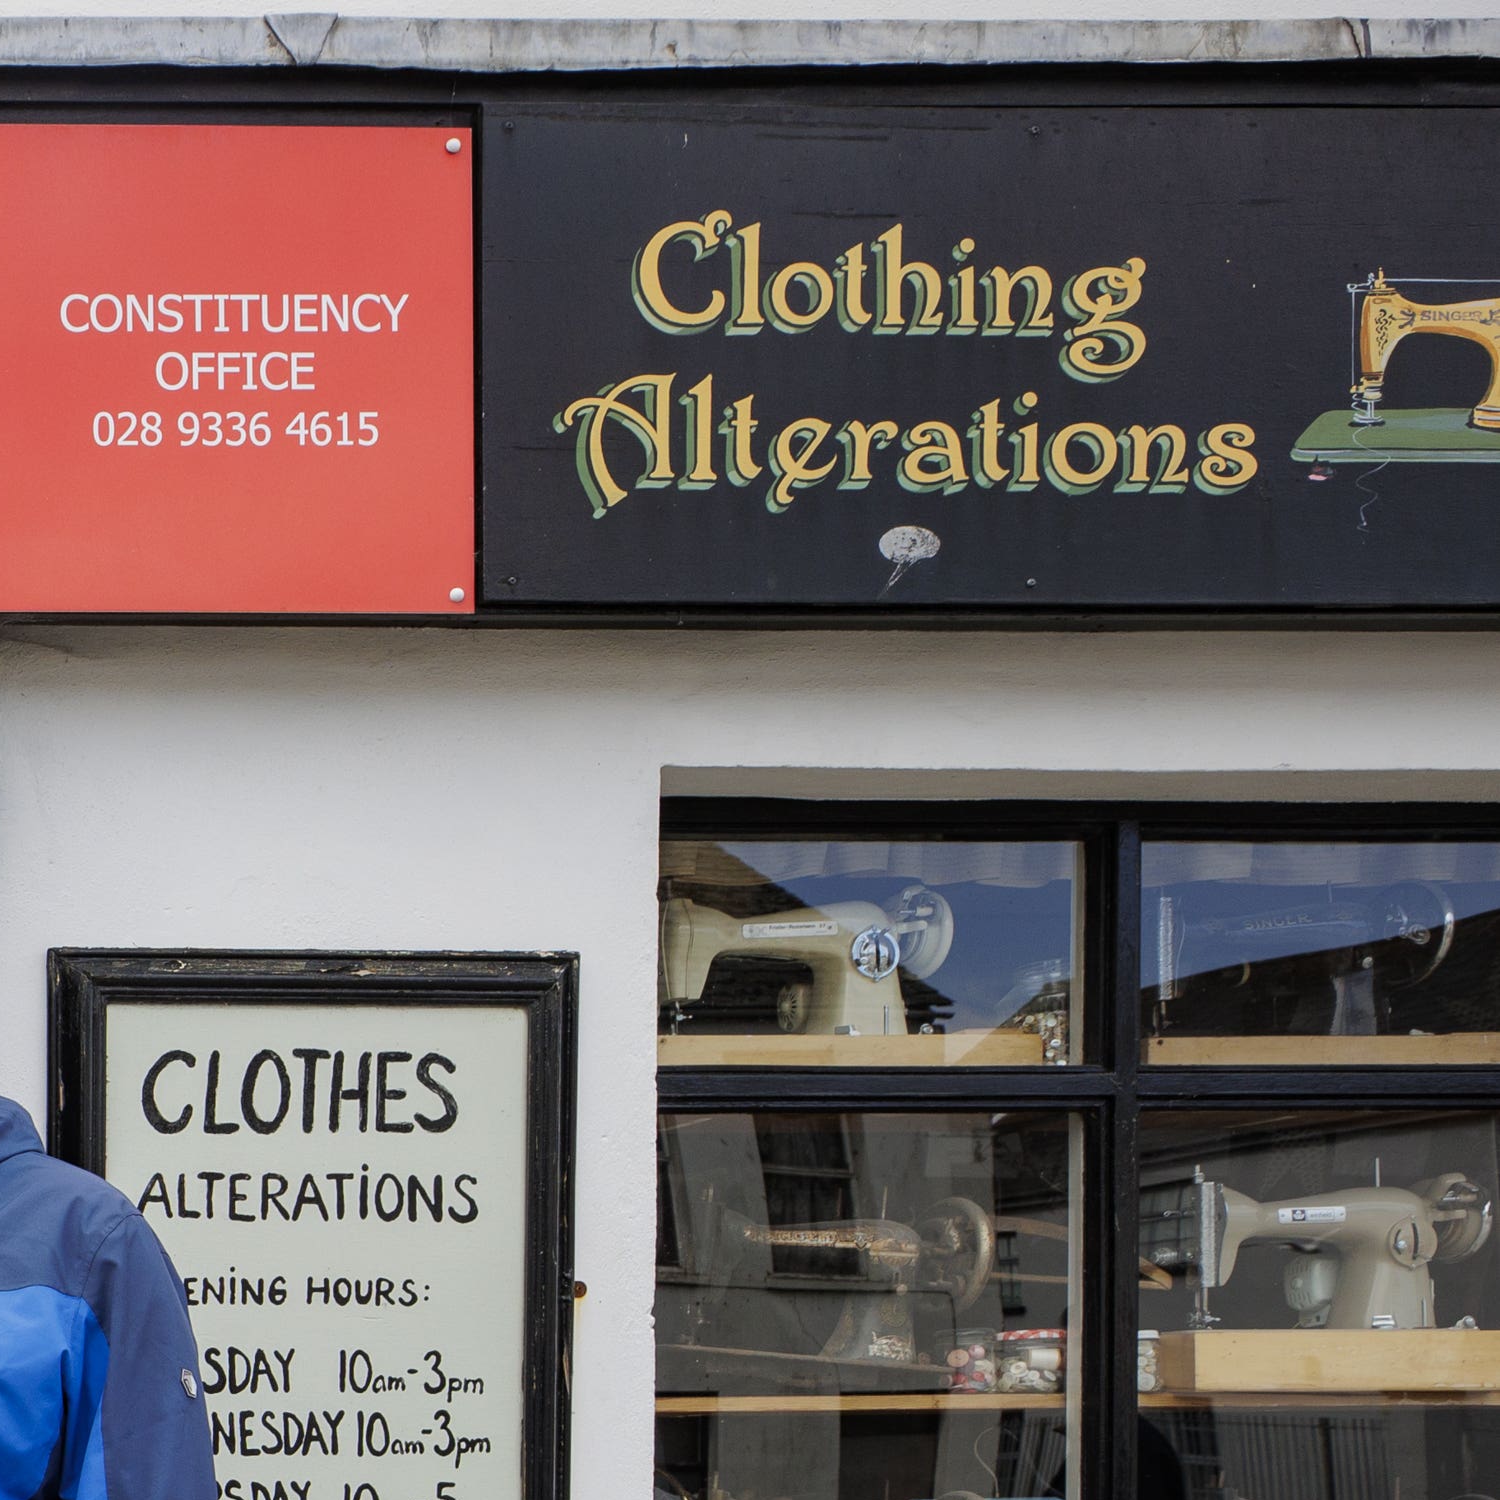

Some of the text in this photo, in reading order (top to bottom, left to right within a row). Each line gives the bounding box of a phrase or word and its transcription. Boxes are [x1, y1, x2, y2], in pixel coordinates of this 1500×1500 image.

[60, 293, 409, 333] CONSTITUENCY
[631, 208, 1148, 383] Clothing
[1420, 309, 1482, 322] SINGER
[155, 351, 315, 391] OFFICE
[92, 411, 379, 447] 028 9336 4615
[552, 371, 1260, 519] Alterations
[141, 1048, 459, 1136] CLOTHES
[138, 1163, 479, 1225] ALTERATIONS
[184, 1266, 431, 1308] ENING HOURS:
[202, 1346, 485, 1406] SDAY 10am-3pm
[211, 1409, 492, 1470] NESDAY 10am-3pm
